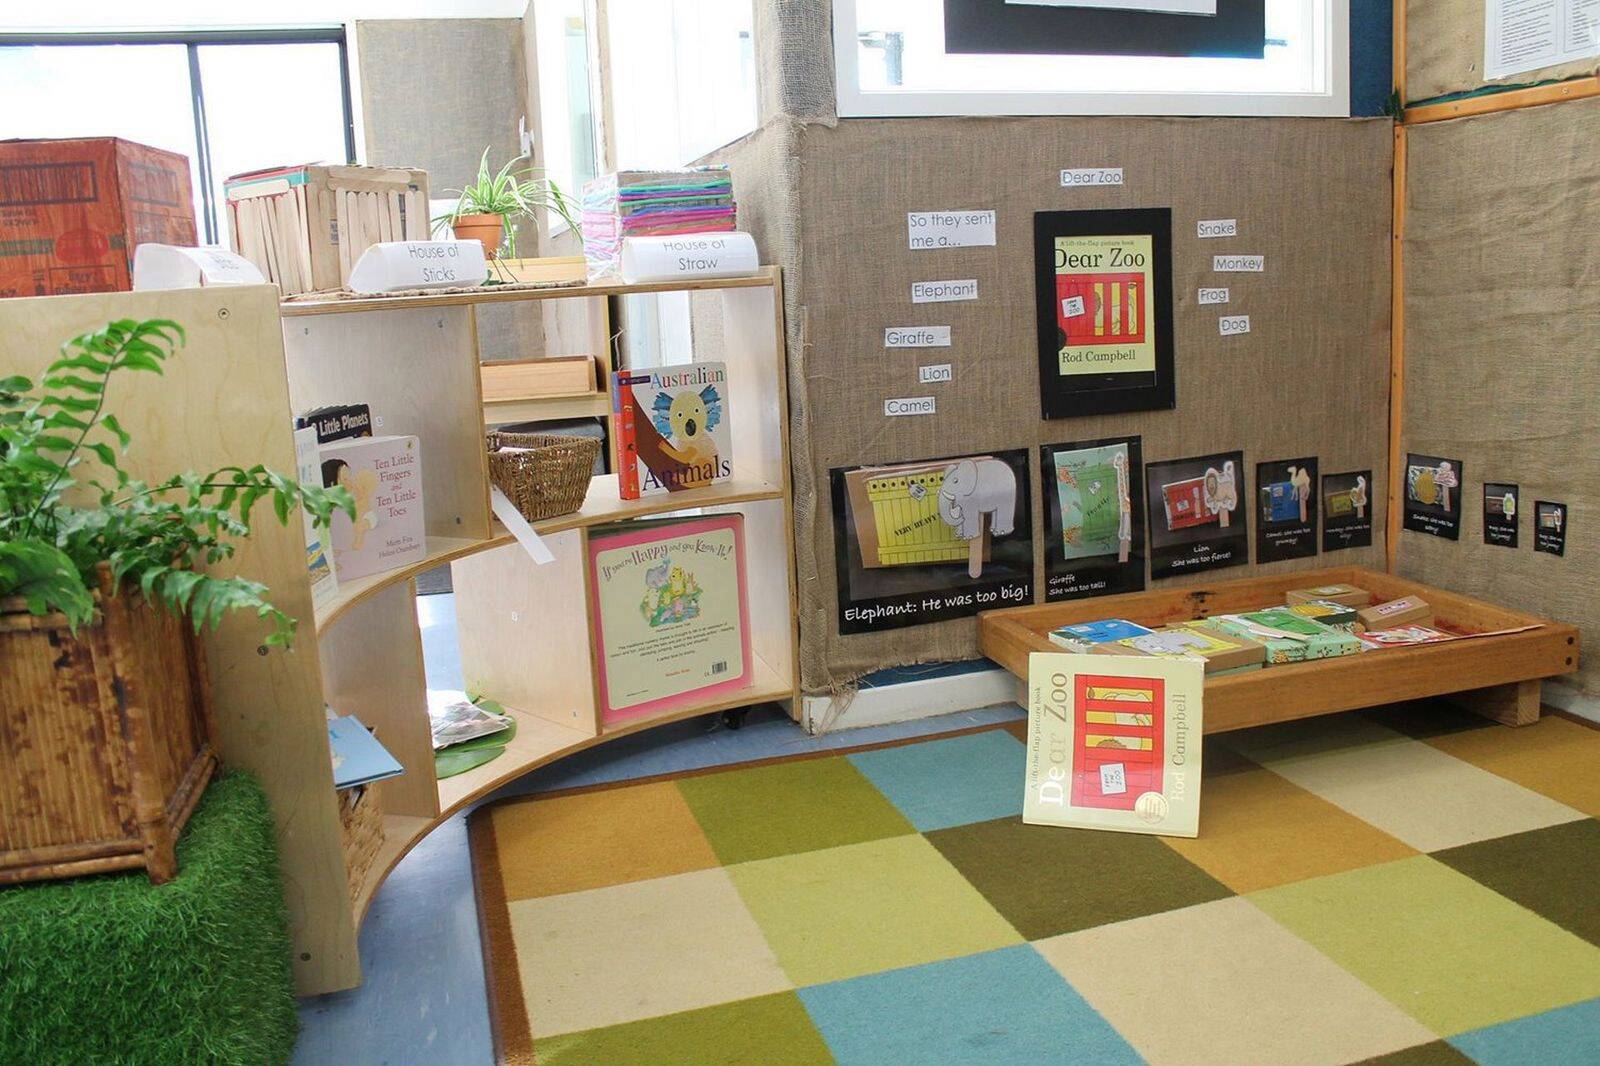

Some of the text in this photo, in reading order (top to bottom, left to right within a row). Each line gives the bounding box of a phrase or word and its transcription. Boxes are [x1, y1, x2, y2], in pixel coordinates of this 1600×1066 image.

[1062, 170, 1121, 184] Dear Zoo
[910, 212, 992, 229] So they sent
[1198, 222, 1235, 236] Snake
[662, 240, 708, 252] House
[911, 236, 961, 247] me a...
[407, 243, 460, 259] House of
[1054, 247, 1145, 269] Dear Zoo
[678, 257, 719, 271] Straw
[1215, 256, 1263, 270] Monkey
[423, 267, 456, 282] Sticks
[914, 283, 975, 299] Elephant
[1200, 289, 1227, 302] Frog
[1221, 319, 1248, 332] Dog
[887, 331, 935, 345] Giraffe
[1062, 349, 1136, 363] Rod Campbell
[650, 367, 724, 390] Australian
[922, 367, 950, 381] Lion
[886, 400, 934, 414] Camel
[320, 417, 341, 437] Little
[341, 412, 369, 431] Planets
[374, 452, 415, 470] Ten Little
[380, 469, 412, 482] Fingers
[643, 455, 731, 491] Animals
[376, 490, 416, 507] Ten Little
[388, 507, 407, 518] Toes
[1193, 545, 1210, 553] Lion
[602, 566, 612, 581] If
[669, 542, 681, 552] and
[682, 543, 695, 553] you
[1211, 552, 1231, 563] fierce!
[1049, 573, 1076, 585] Giraffe
[1049, 580, 1106, 597] She was too tall!
[844, 583, 1030, 623] Elephant: He was too big!
[1034, 707, 1042, 735] picture
[1039, 672, 1068, 806] Dear Zoo
[1171, 693, 1190, 802] Rod Campbell
